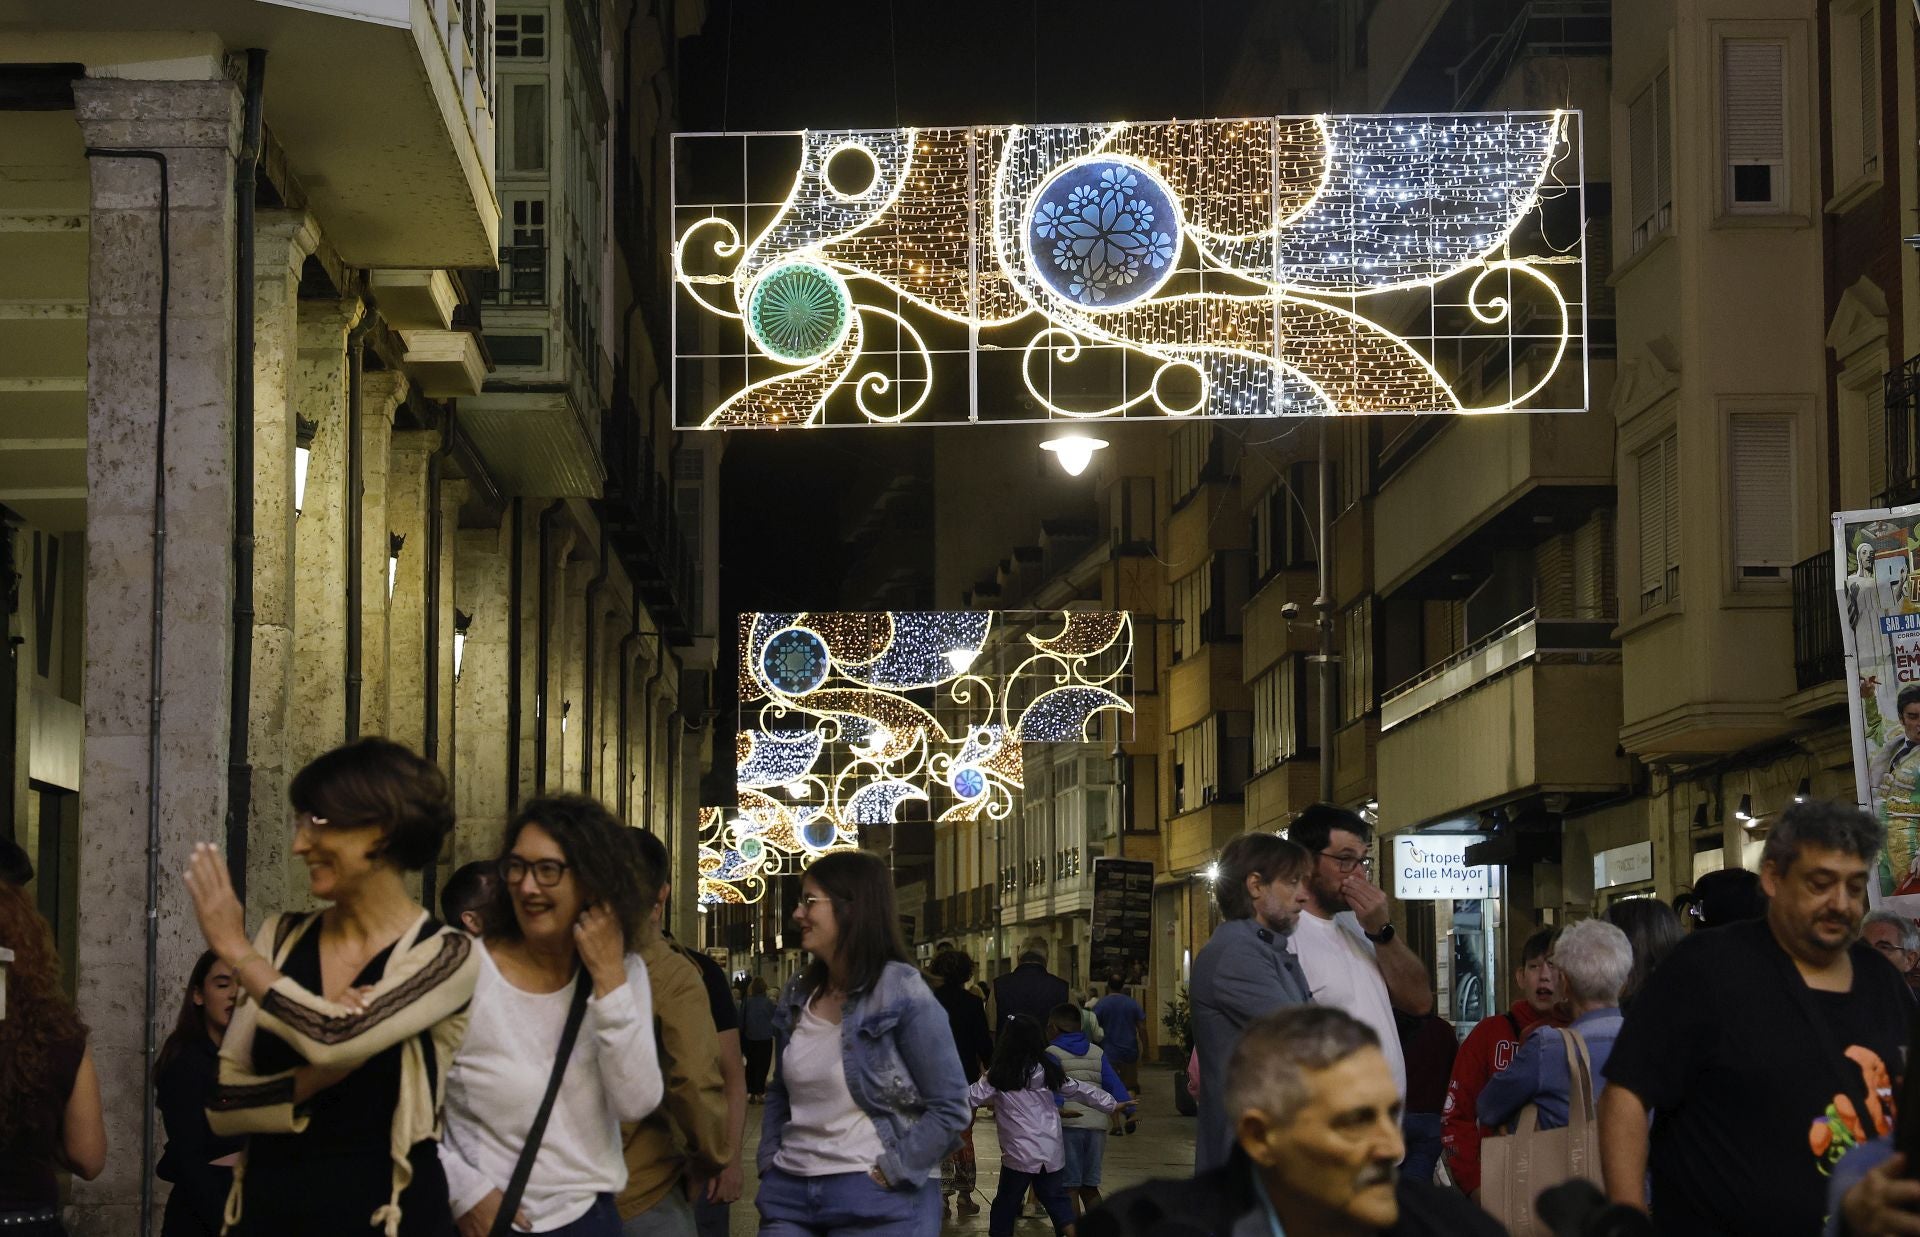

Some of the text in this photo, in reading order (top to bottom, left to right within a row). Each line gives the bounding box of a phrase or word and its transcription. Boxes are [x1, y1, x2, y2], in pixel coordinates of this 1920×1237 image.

[1904, 614, 1915, 629] 30
[1895, 645, 1909, 655] M.
[1897, 668, 1920, 683] CL
[1404, 867, 1483, 881] Calle Mayor
